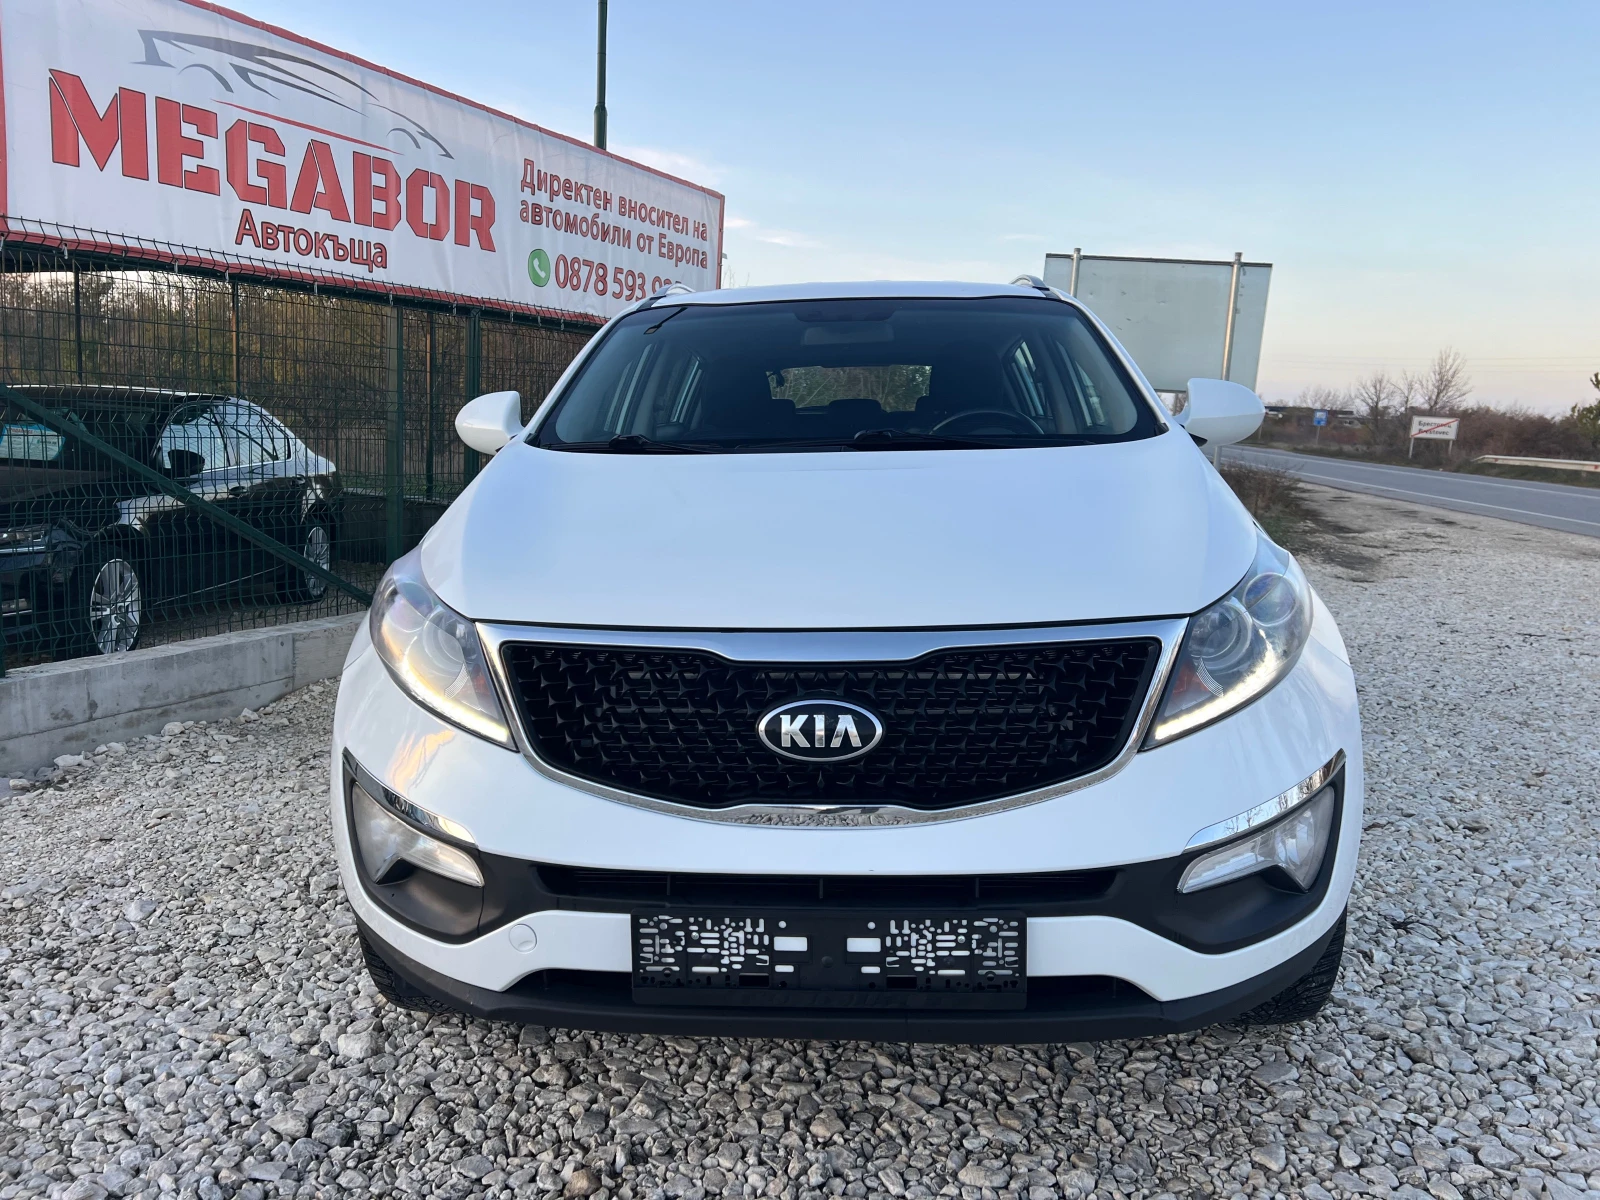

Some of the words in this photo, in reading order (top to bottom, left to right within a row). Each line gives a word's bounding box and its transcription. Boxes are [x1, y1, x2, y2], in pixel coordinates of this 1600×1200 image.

[49, 68, 496, 252] MEGABOR
[520, 158, 613, 213] Директен
[618, 195, 689, 236] вносител
[693, 220, 708, 242] на
[234, 208, 388, 273] Автокъща
[519, 199, 632, 250] автомобили
[636, 232, 655, 255] от
[658, 232, 708, 270] Европа
[554, 253, 609, 297] 0878
[611, 266, 647, 302] 593
[780, 714, 862, 748] KIA
